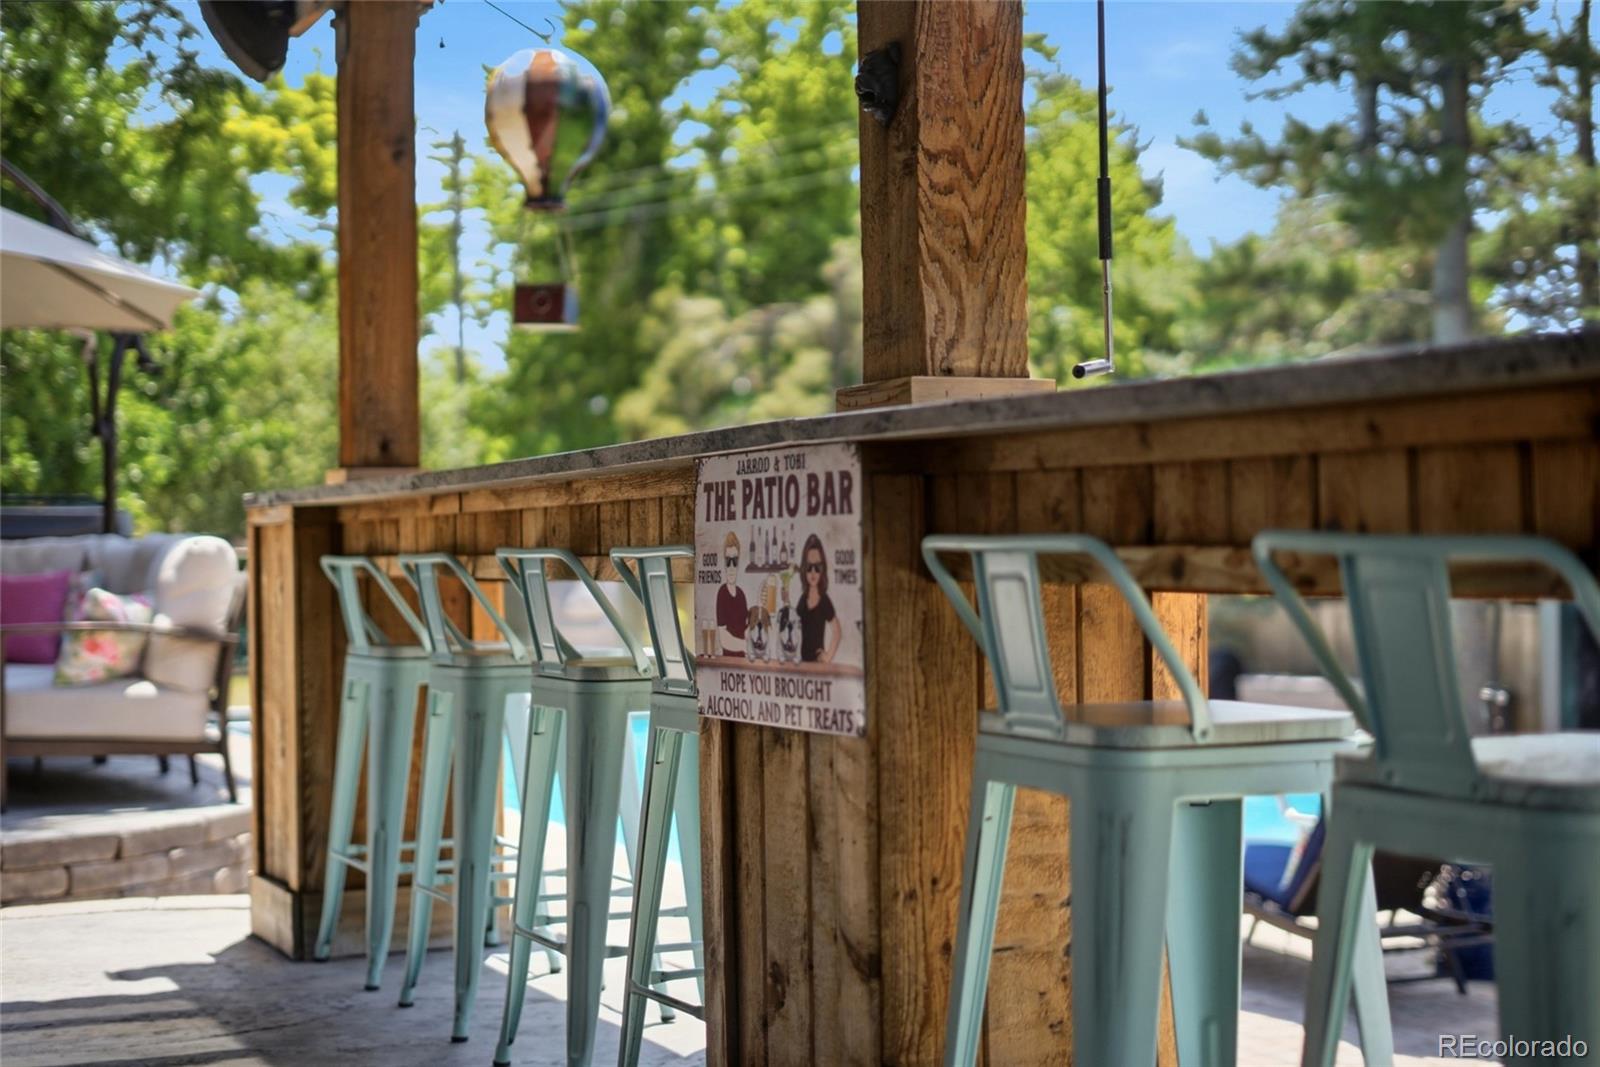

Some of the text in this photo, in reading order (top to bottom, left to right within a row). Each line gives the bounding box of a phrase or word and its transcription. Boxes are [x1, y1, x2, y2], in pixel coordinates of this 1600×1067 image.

[736, 455, 770, 476] JARROD
[773, 458, 780, 473] &
[703, 470, 853, 522] THE PATIO BAR
[702, 553, 718, 567] GOOD
[834, 549, 855, 565] GOOD
[698, 570, 722, 585] FRIENDS
[834, 568, 857, 585] TIMES
[720, 672, 832, 702] HOPE YOU BROUGHT
[706, 695, 853, 733] ALCOHOL AND PET TREATS
